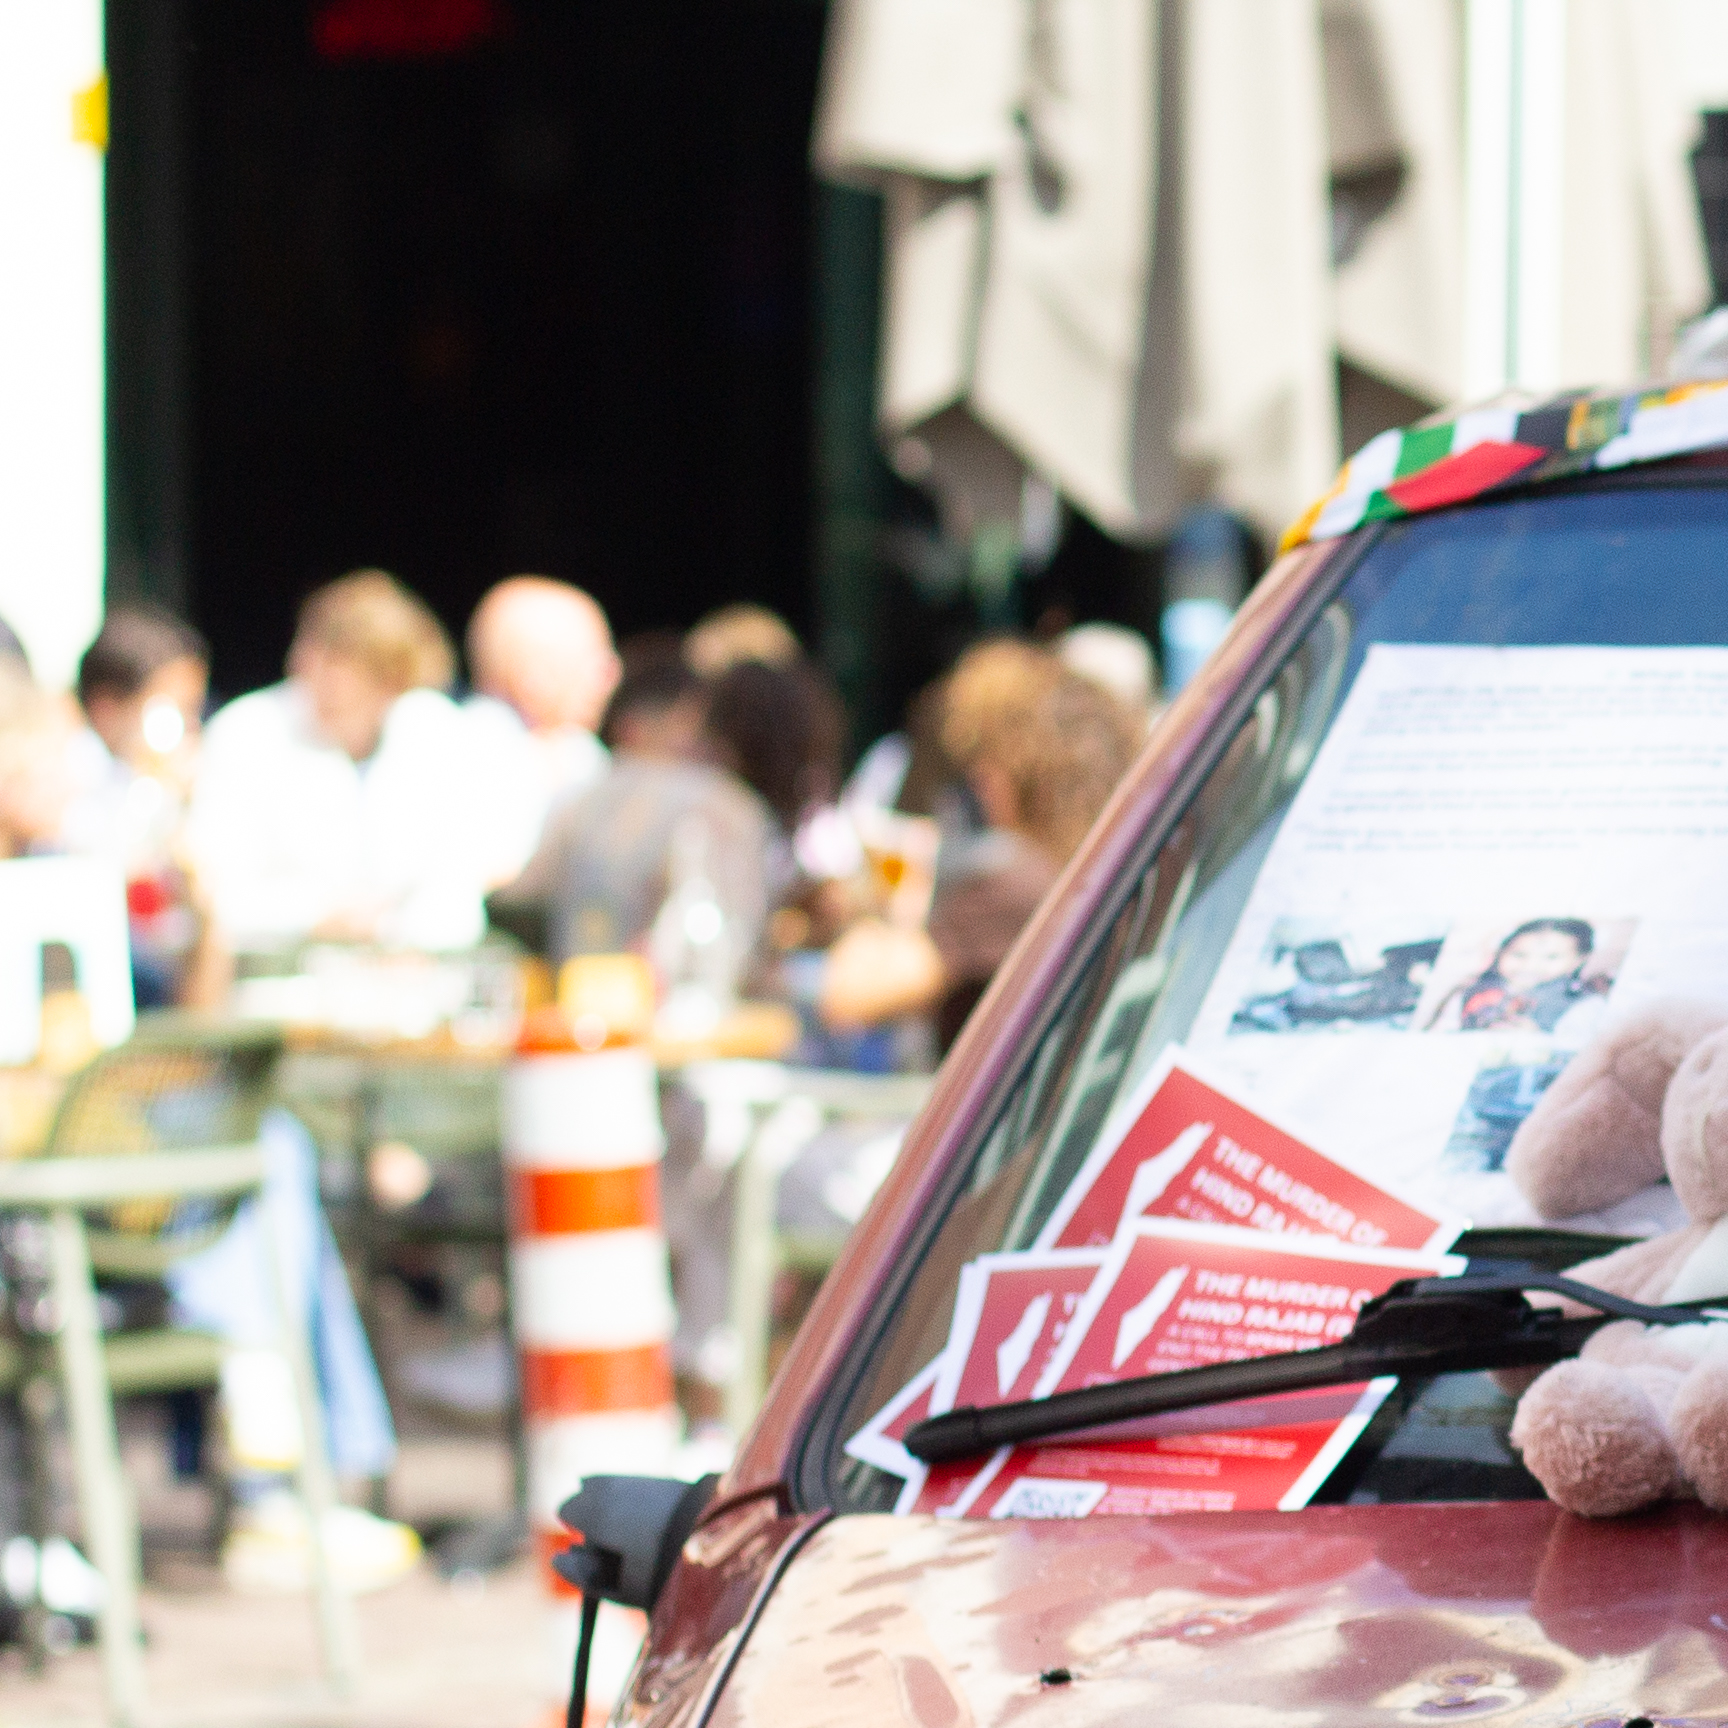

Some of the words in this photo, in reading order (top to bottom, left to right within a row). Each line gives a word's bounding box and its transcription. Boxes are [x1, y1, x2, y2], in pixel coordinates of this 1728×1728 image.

[1190, 1165, 1256, 1218] HIND
[1213, 1135, 1264, 1182] THE
[1257, 1165, 1357, 1234] MURDER
[1194, 1270, 1245, 1297] THE
[1243, 1275, 1351, 1311] MURDER
[1177, 1297, 1244, 1327] HIND
[1243, 1305, 1326, 1336] RAJAB
